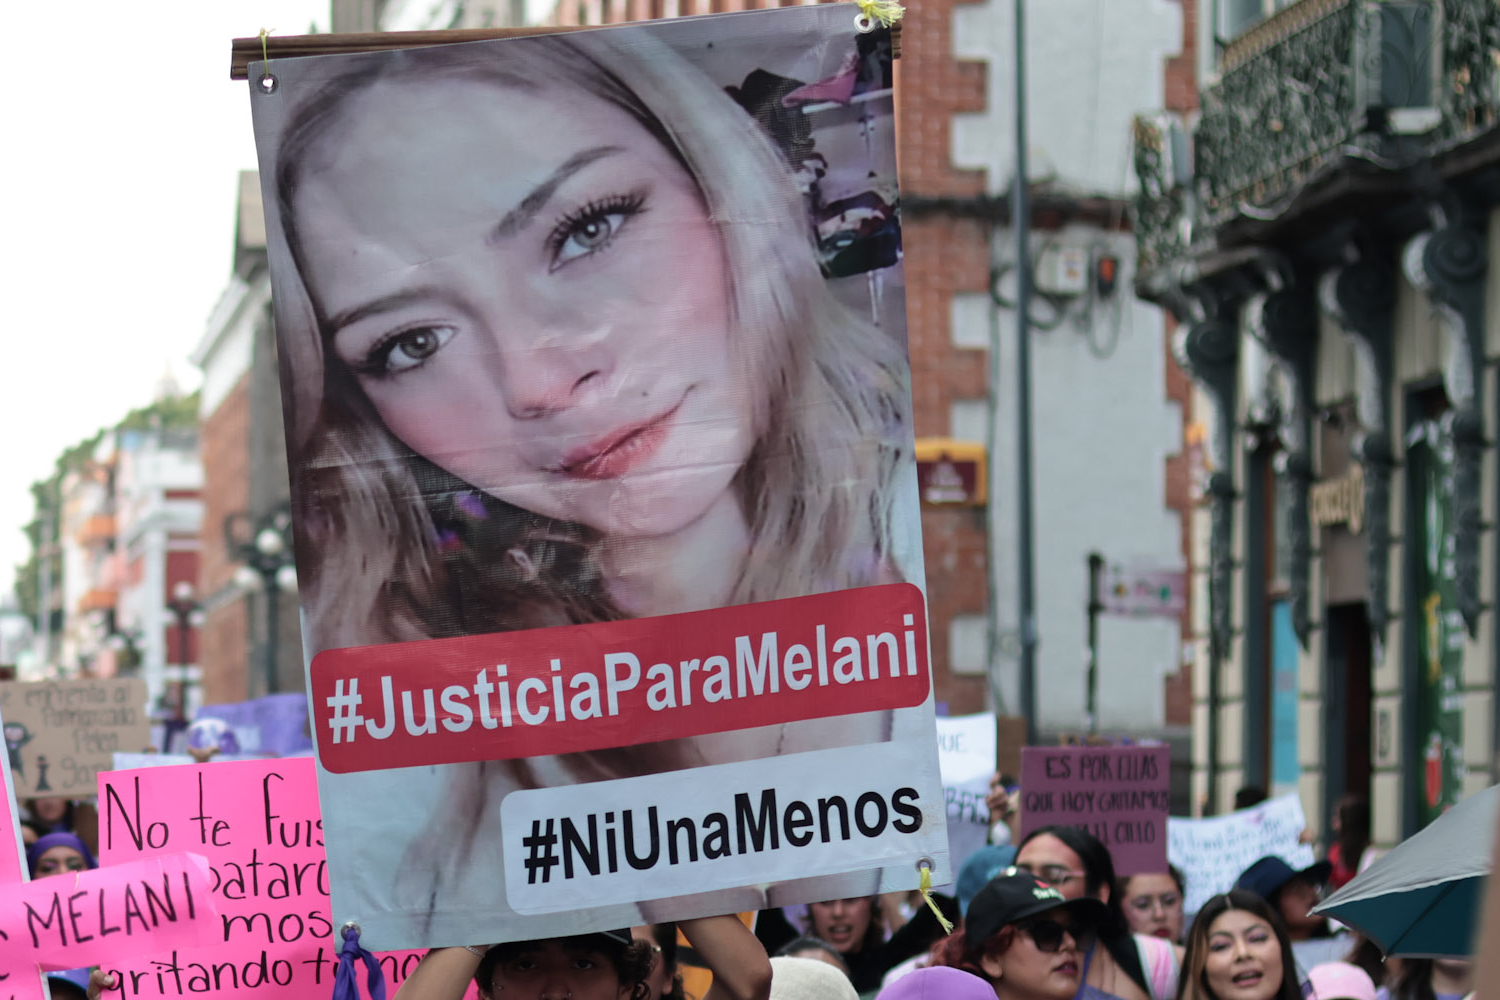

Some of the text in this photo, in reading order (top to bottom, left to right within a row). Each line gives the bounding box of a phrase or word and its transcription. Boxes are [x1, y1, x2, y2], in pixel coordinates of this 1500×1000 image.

[327, 613, 919, 745] #JusticiaParaMelani
[1045, 755, 1072, 779] ES
[105, 775, 170, 852] No
[189, 771, 232, 846] te
[523, 786, 923, 885] #NiUnaMenos
[22, 871, 197, 949] MELANI
